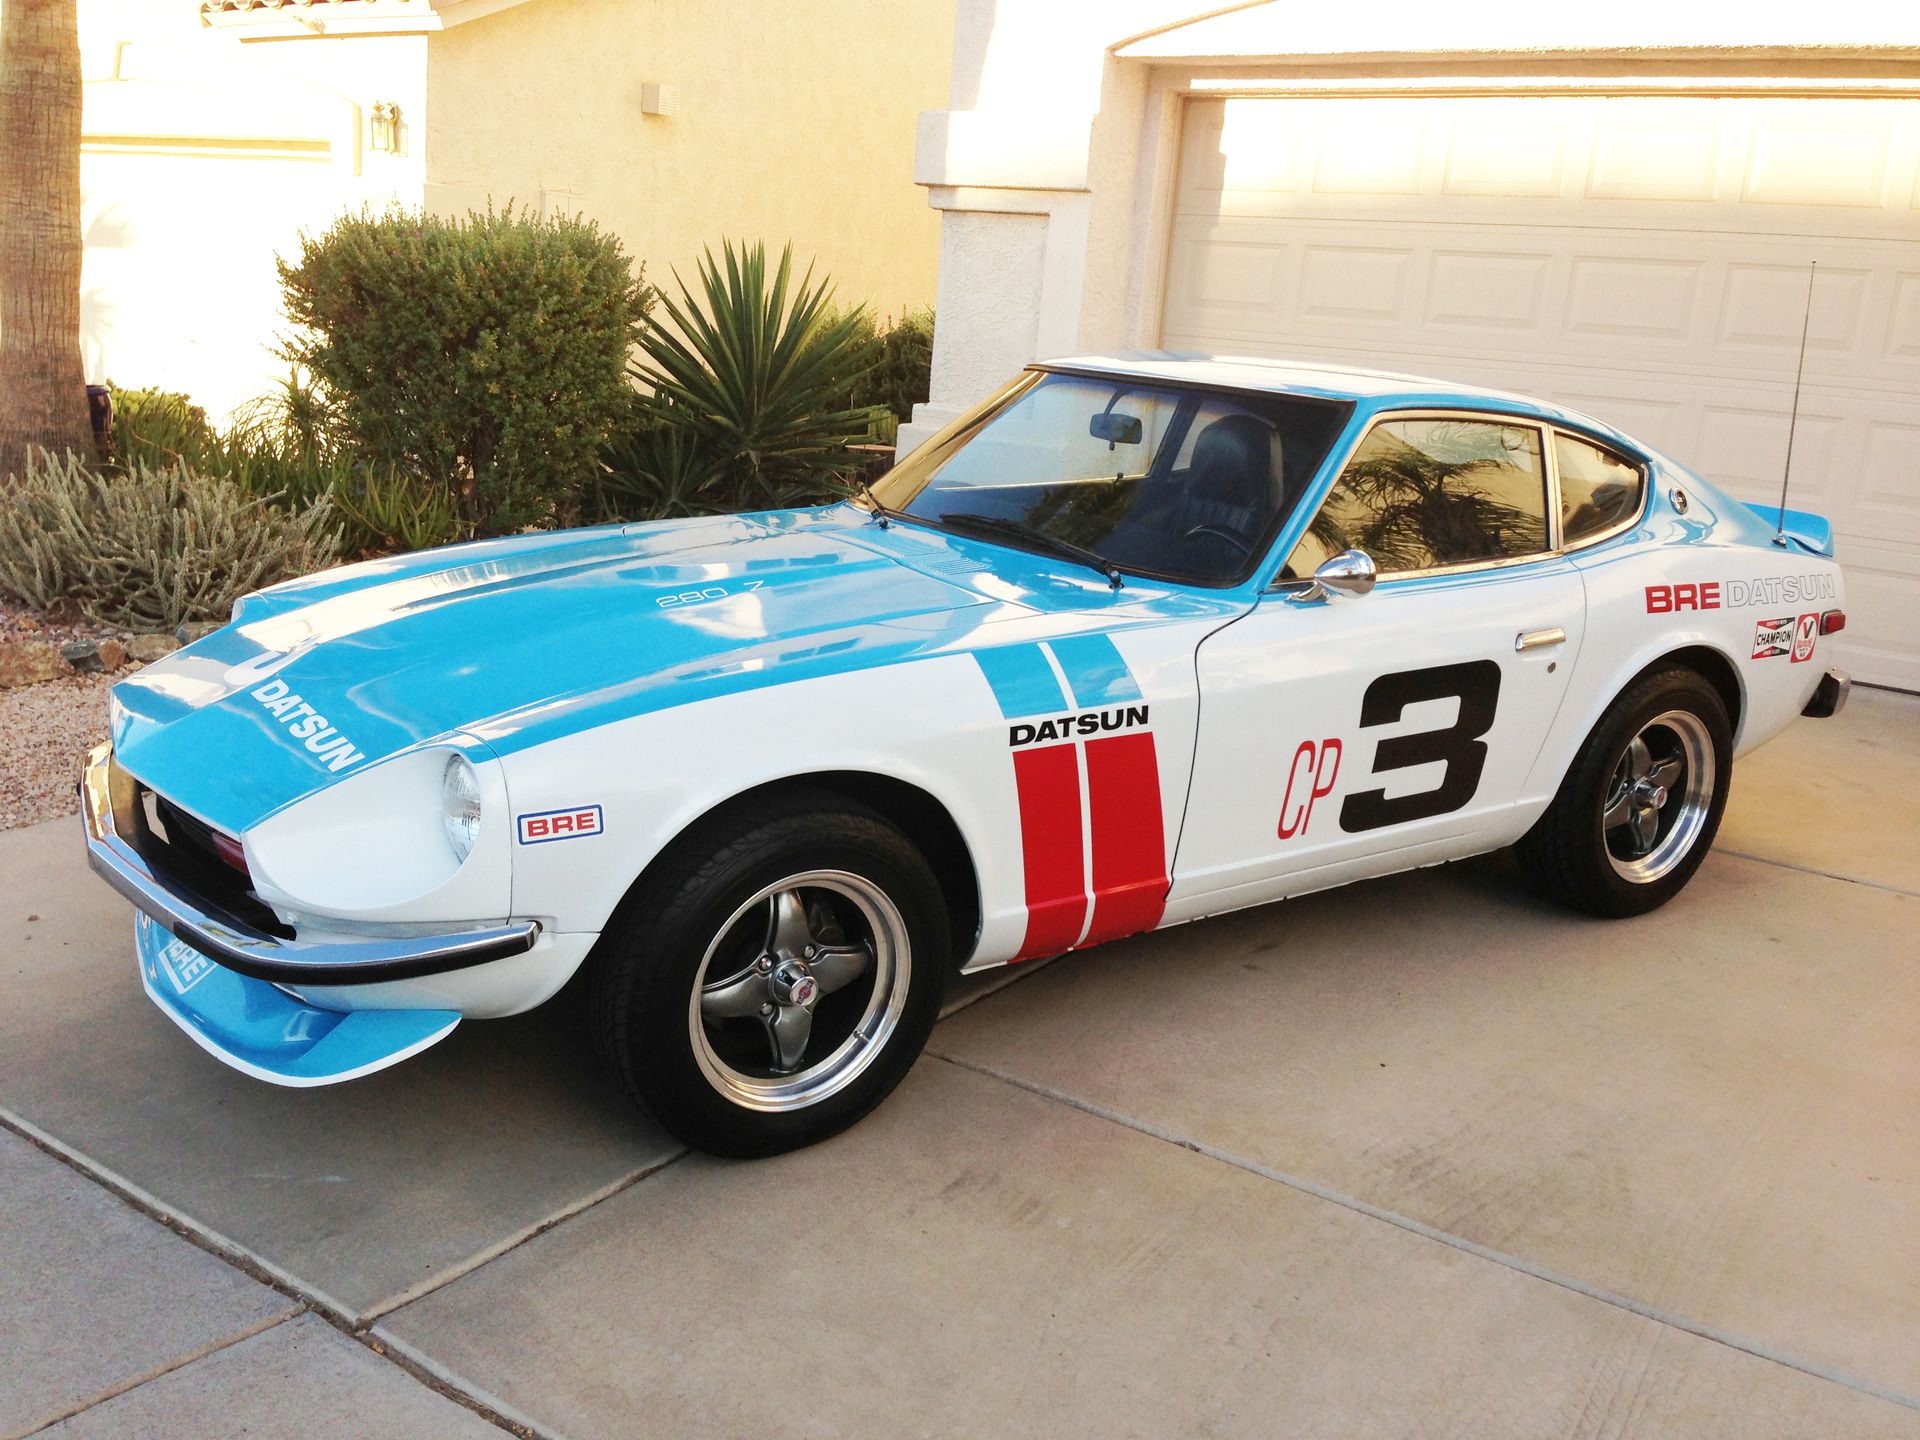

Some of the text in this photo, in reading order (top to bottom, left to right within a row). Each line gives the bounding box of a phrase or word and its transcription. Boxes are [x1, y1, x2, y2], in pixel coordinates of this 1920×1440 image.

[656, 580, 772, 608] 280 Z
[1645, 573, 1836, 614] BRE DATSUN
[1756, 630, 1792, 646] CHAMPION
[250, 678, 366, 773] DATSUN
[1009, 705, 1149, 747] DATSUN
[1339, 659, 1502, 833] 3
[1278, 738, 1342, 840] CP
[527, 812, 595, 837] BRE
